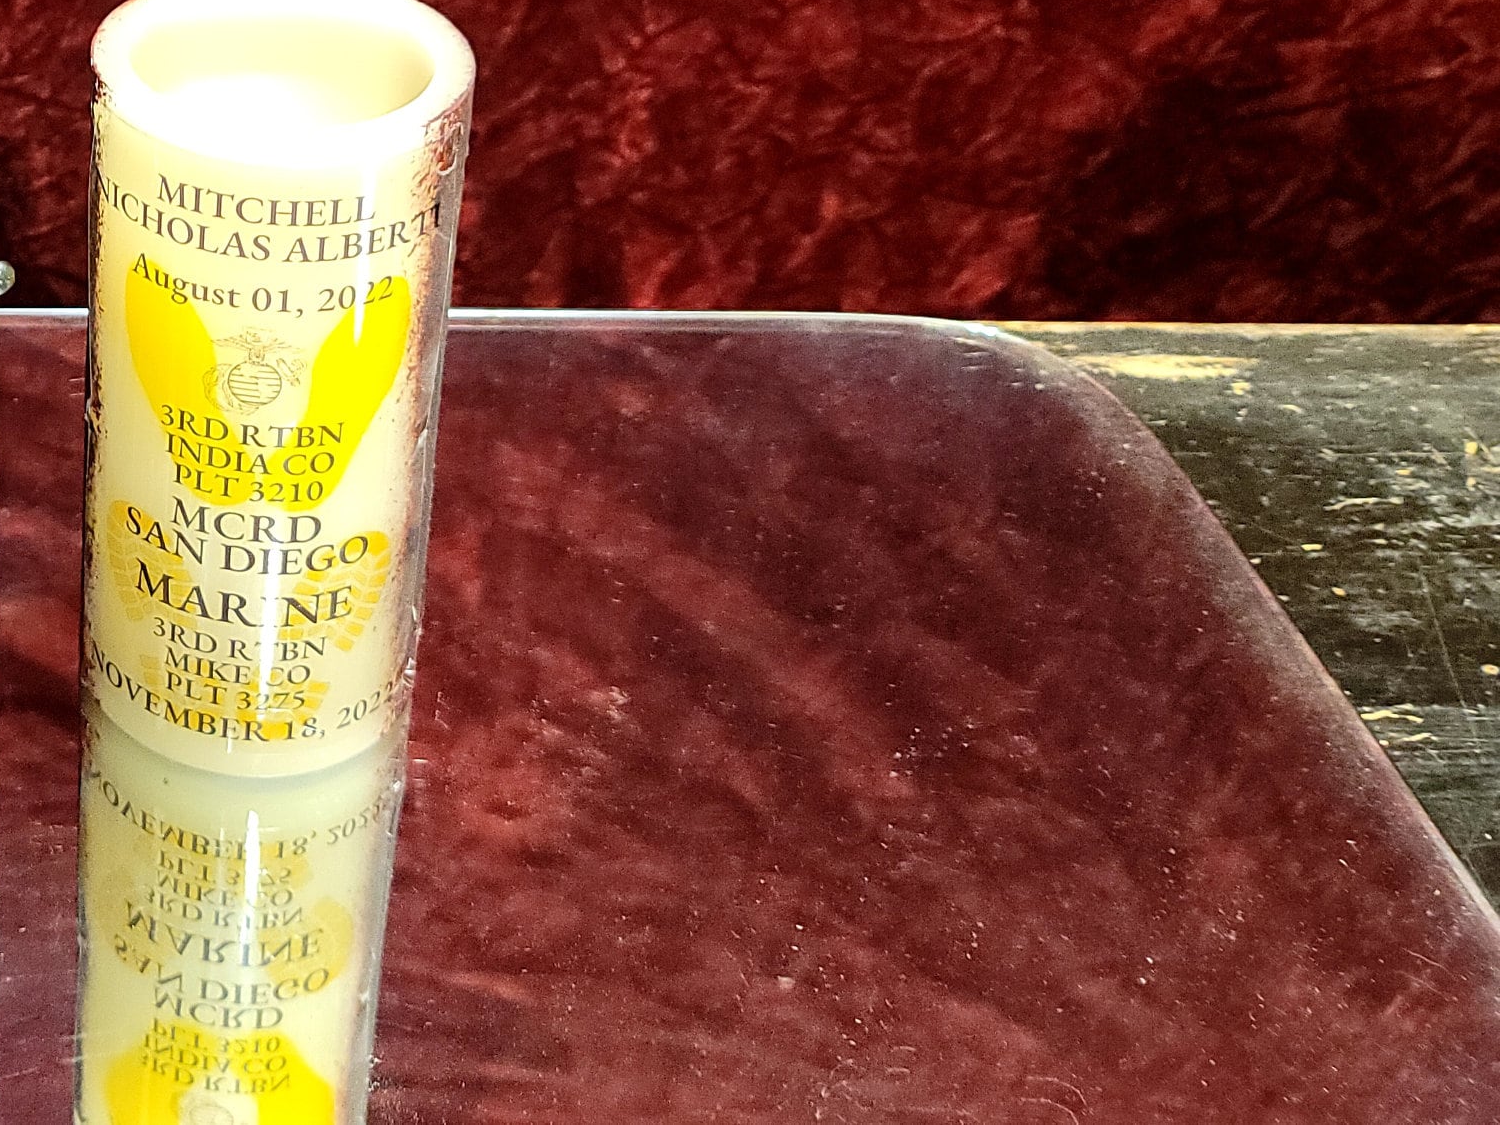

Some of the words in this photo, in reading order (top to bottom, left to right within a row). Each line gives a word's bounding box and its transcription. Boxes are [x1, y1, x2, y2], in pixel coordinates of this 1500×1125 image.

[96, 165, 271, 262] NICHOLAS
[157, 173, 377, 227] MITCHELL
[132, 253, 241, 308] August
[251, 287, 304, 318] 01,
[317, 275, 393, 312] 2022
[161, 404, 228, 441] 3RD
[165, 431, 271, 475] INDIA
[283, 451, 335, 476] CO
[173, 463, 240, 497] PLT
[249, 481, 324, 503] 3210
[126, 506, 207, 565] SAN
[220, 535, 369, 576] DIEGO
[171, 495, 322, 544] MCRD
[135, 557, 352, 628] MARNE
[153, 617, 217, 653] 3RD
[91, 638, 269, 742] NOVEMBER
[164, 646, 251, 685] MIKE
[265, 664, 311, 687] CO
[166, 671, 227, 705] PLT
[237, 690, 305, 710] 3275
